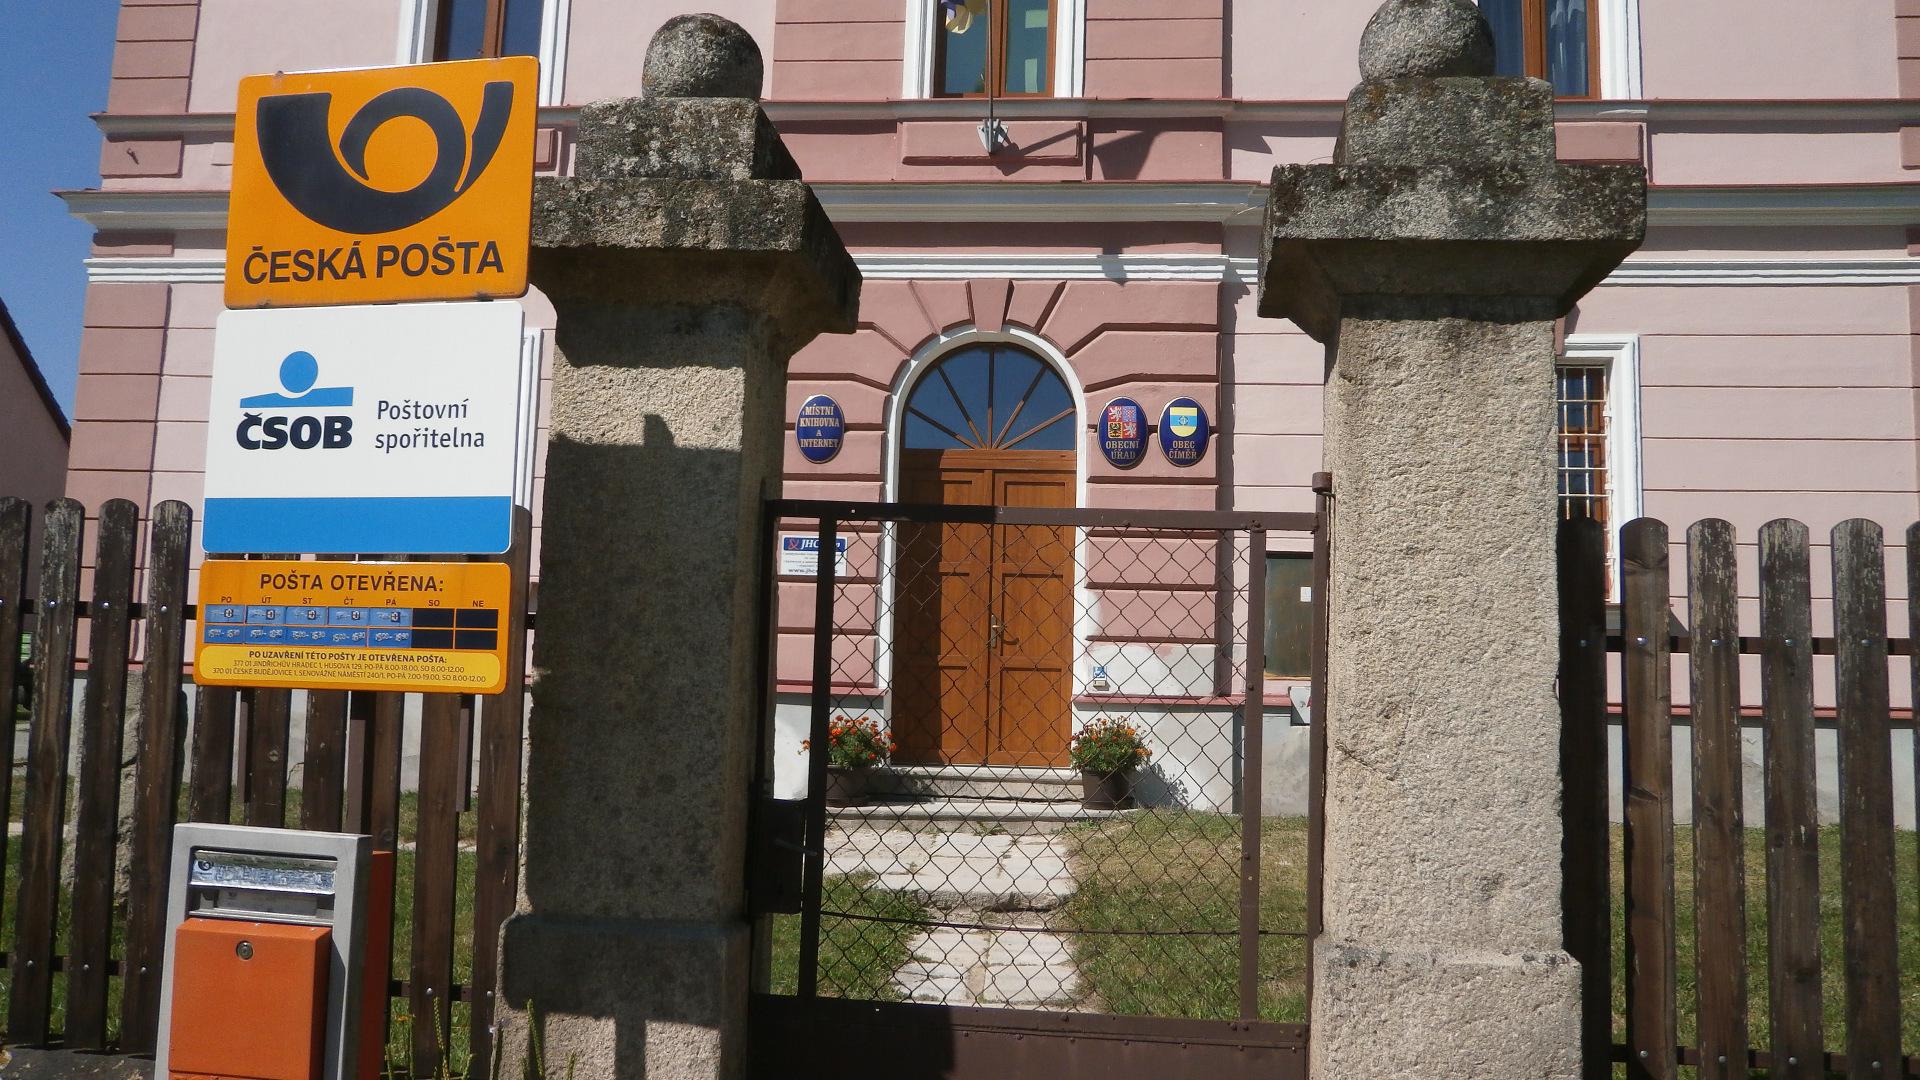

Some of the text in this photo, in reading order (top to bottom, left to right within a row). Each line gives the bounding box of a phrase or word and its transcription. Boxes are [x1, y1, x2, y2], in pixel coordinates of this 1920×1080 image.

[244, 235, 504, 284] ČESKÁ POŠTA
[377, 398, 470, 420] Poštovní
[805, 403, 835, 416] MÍSTNÍ
[799, 417, 840, 427] KNIHOVNA
[236, 412, 353, 450] ČSOB
[815, 429, 822, 437] A
[375, 427, 485, 454] spořitelna
[800, 438, 839, 448] INTERNET
[1105, 438, 1140, 449] OBECNÍ
[1172, 440, 1195, 449] OBEC
[1111, 447, 1136, 460] ÚŘAD
[260, 569, 444, 592] POŠTA OTEVŘENA:
[302, 597, 313, 605] ST
[343, 596, 354, 605] ČT
[428, 599, 440, 607] SO
[472, 599, 484, 607] NE
[249, 650, 447, 664] PO UZAVŘENÍ TÉTO POŠTY JE OTEVŘENA POŠTA:
[232, 667, 253, 675] ČESKÉ
[253, 668, 293, 676] BUDĚJOVICE
[291, 661, 318, 669] HRADEC
[324, 662, 350, 670] HUSOVA
